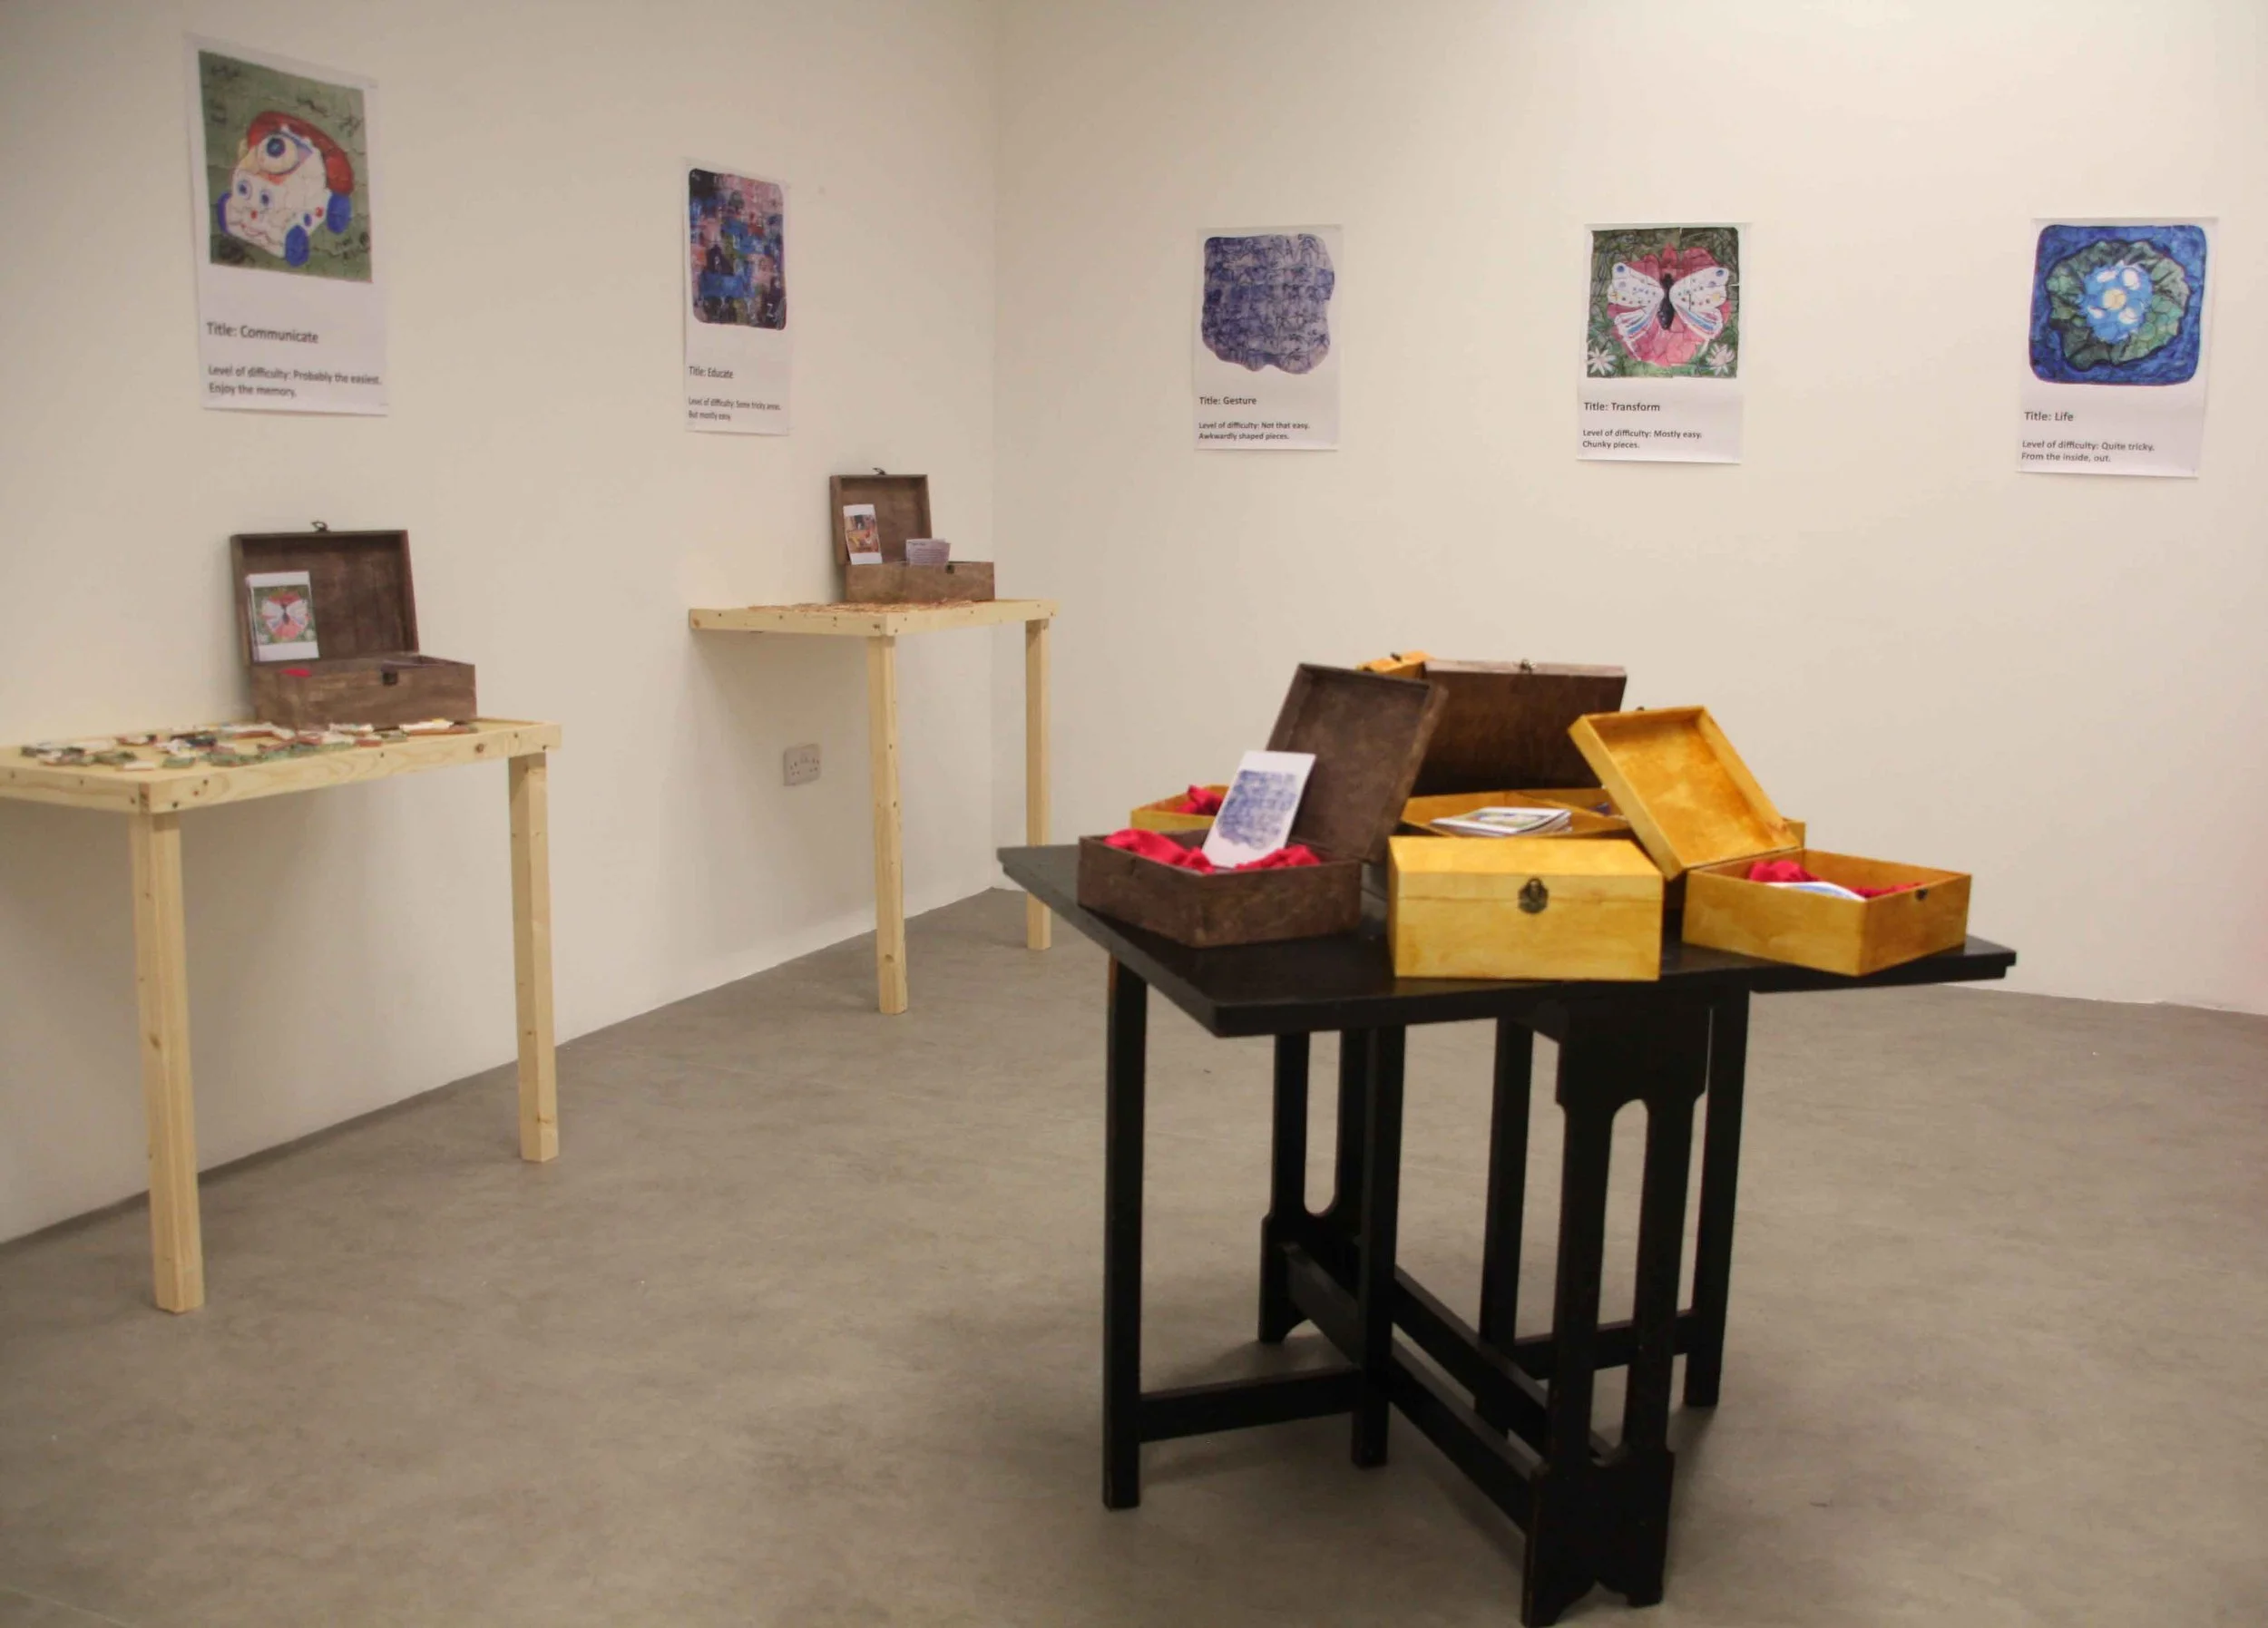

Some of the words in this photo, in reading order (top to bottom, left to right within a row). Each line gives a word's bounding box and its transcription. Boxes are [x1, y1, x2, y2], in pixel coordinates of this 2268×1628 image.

[207, 322, 237, 337] Title:
[240, 325, 319, 344] Communicate
[209, 366, 233, 376] Level
[236, 366, 246, 376] of
[293, 370, 333, 384] Probably
[335, 373, 348, 383] the
[209, 383, 236, 395] Enjoy
[238, 385, 253, 395] the
[1223, 396, 1256, 405] Gesture
[1584, 403, 1608, 411] Title:
[1611, 403, 1660, 412] Transform
[2025, 412, 2051, 421] Title:
[2055, 412, 2074, 421] Life
[1615, 430, 1651, 438] difficulty:
[1583, 441, 1610, 449] Chunky
[2058, 441, 2098, 450] difficulty:
[2128, 443, 2155, 452] tricky.
[2021, 453, 2043, 461] From
[2047, 453, 2060, 461] the
[2063, 453, 2090, 463] inside,
